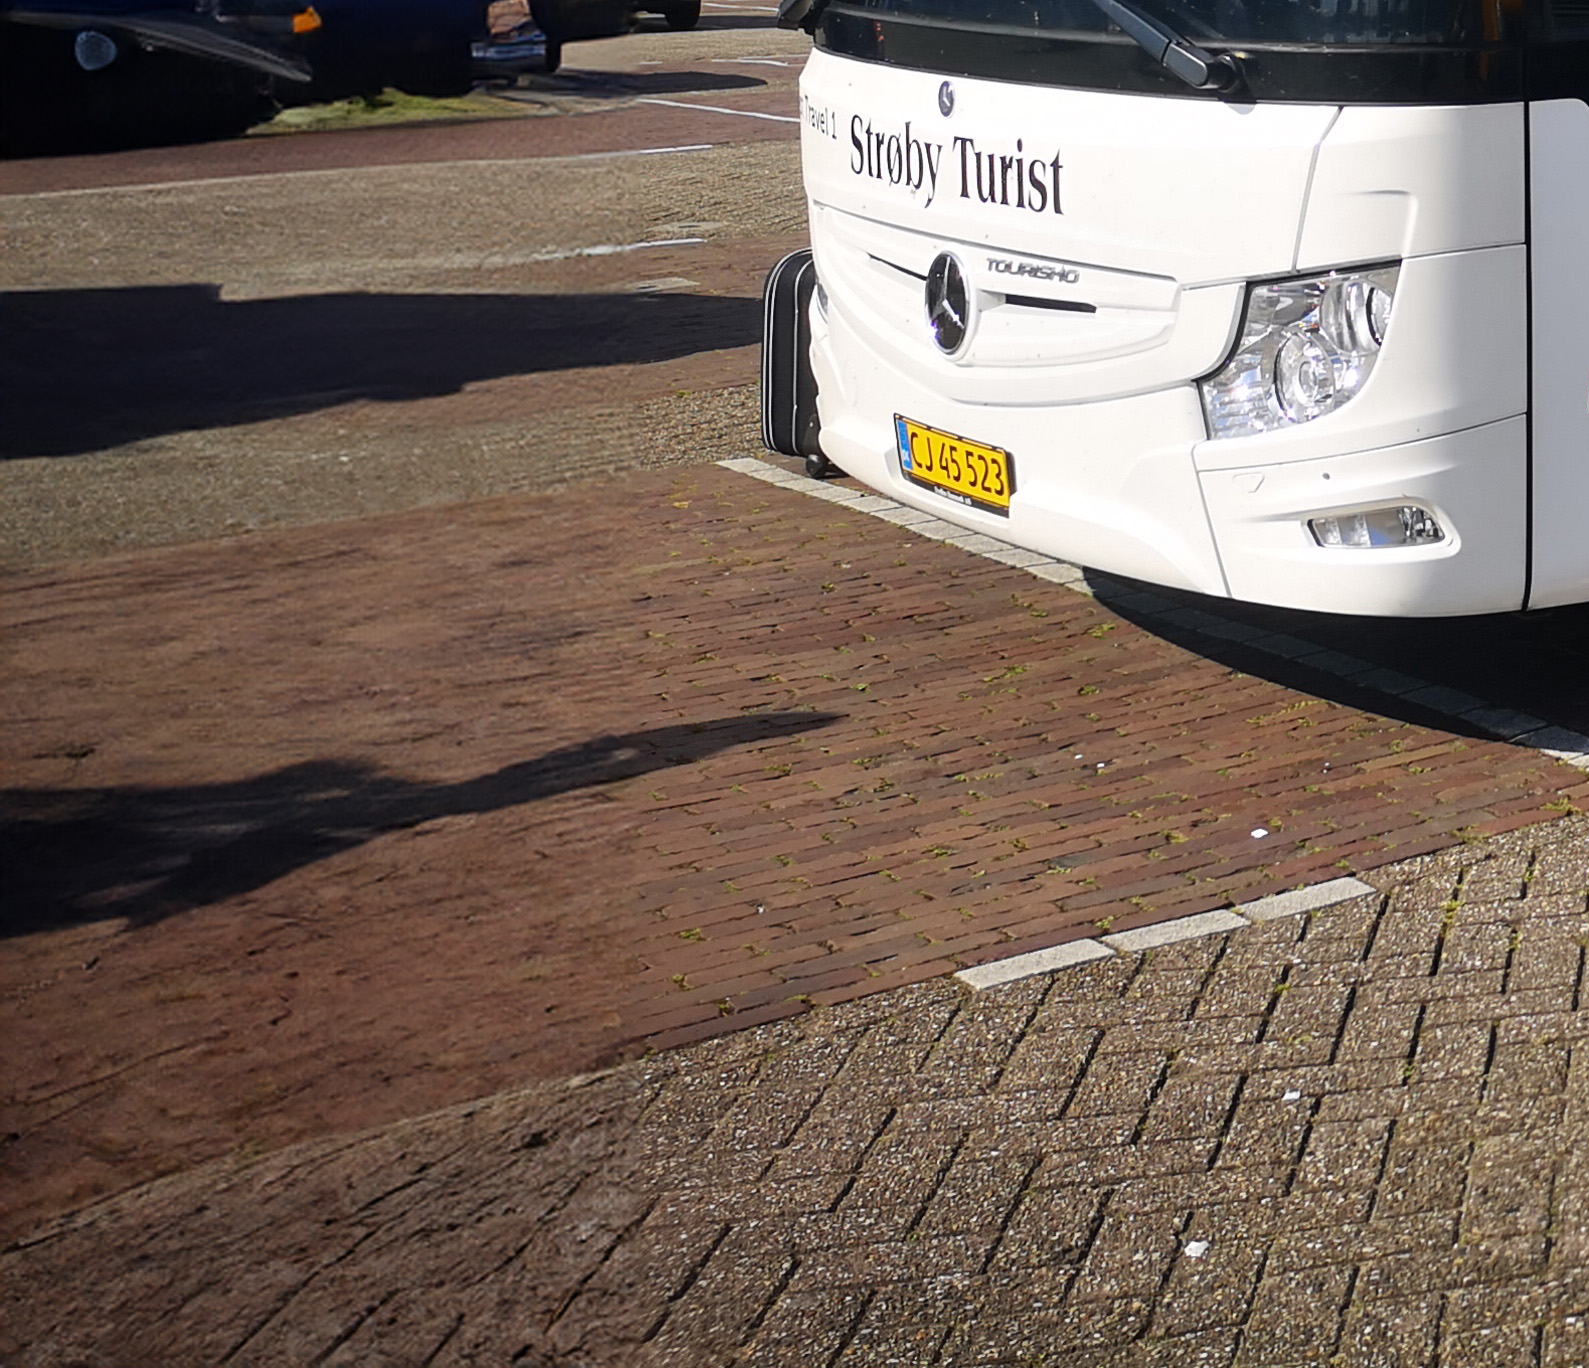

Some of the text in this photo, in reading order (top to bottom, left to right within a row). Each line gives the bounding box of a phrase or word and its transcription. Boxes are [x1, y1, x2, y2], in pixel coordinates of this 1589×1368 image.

[850, 114, 1064, 215] Strøby Turist
[986, 257, 1080, 284] TOURISMO
[910, 431, 933, 473] CJ
[939, 442, 961, 482] 45
[965, 450, 1004, 496] 523
